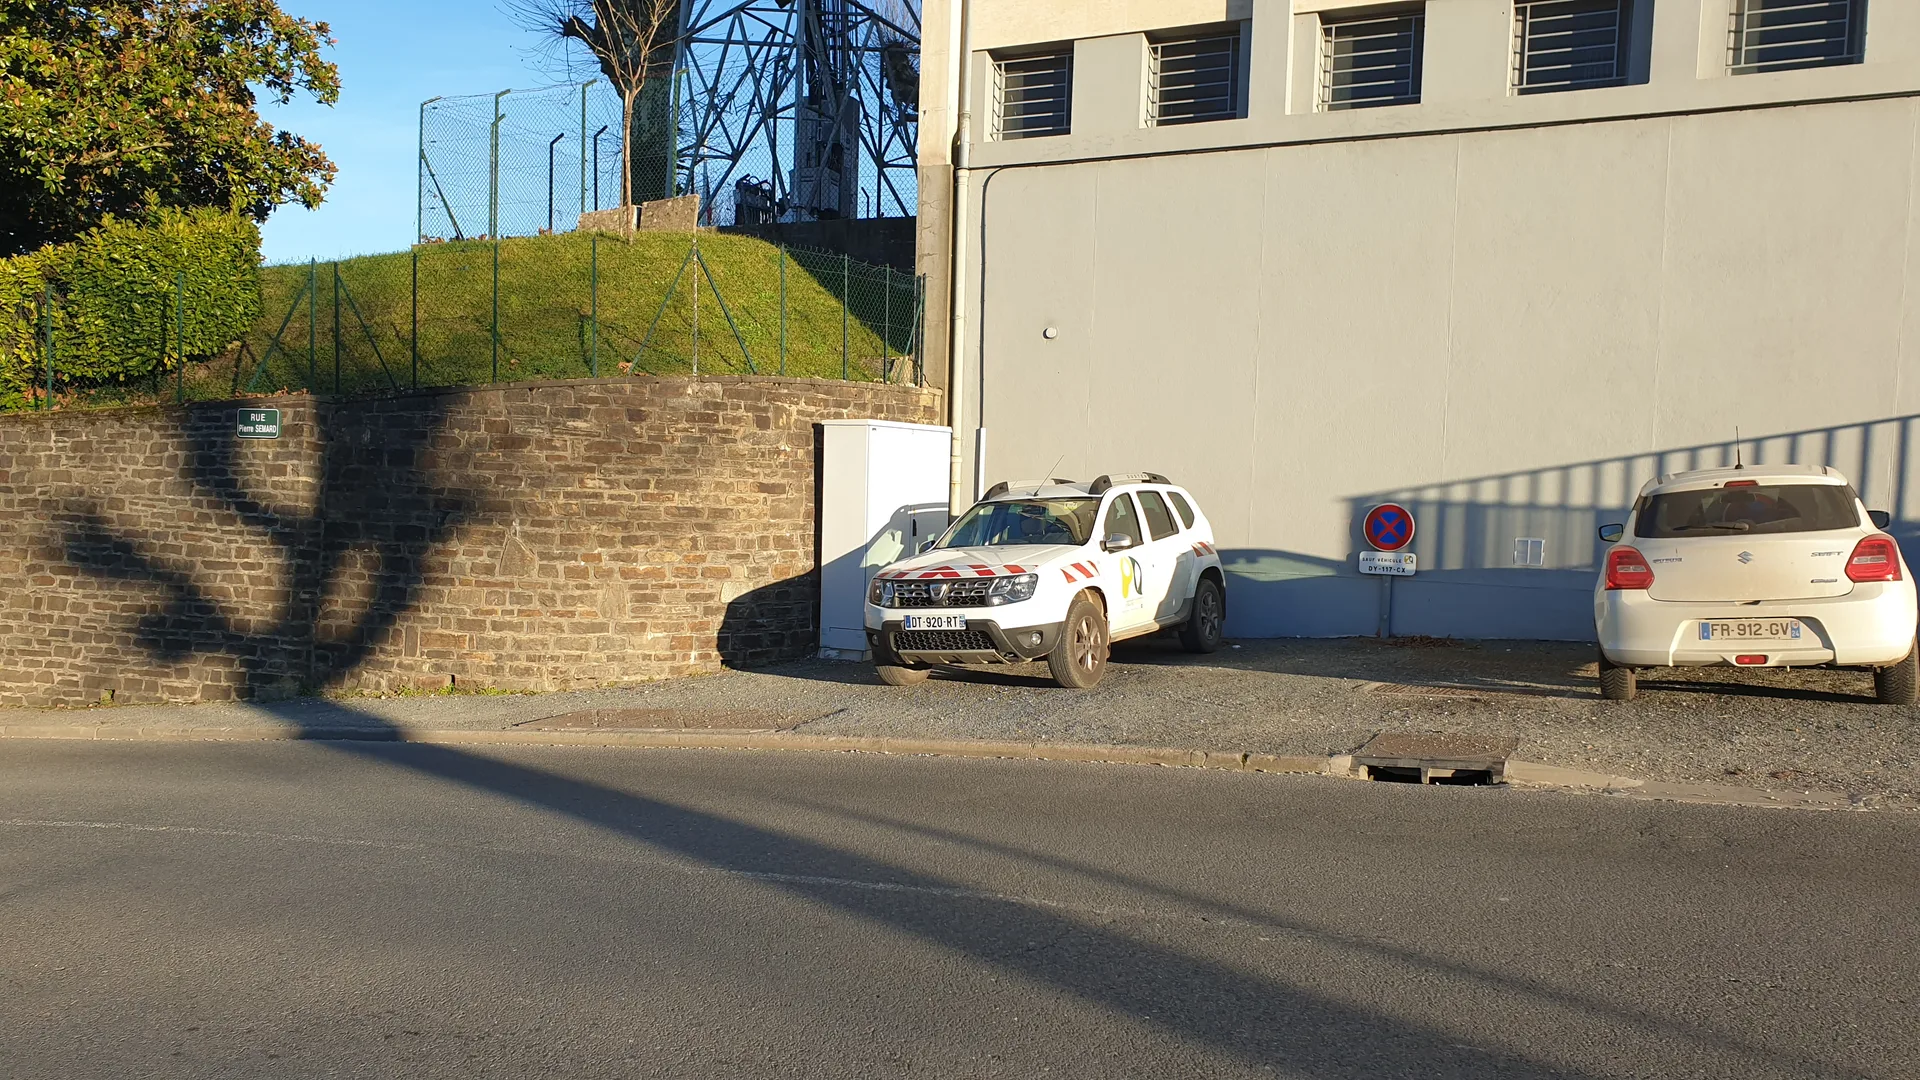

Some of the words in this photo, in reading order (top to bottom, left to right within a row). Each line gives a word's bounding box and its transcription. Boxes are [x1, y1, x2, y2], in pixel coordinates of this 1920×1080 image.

[250, 413, 266, 422] RUE
[238, 424, 254, 433] Pierre
[255, 424, 277, 433] SEMARD
[911, 616, 958, 628] DT-920-RT
[1710, 622, 1789, 637] FR-912-GV
